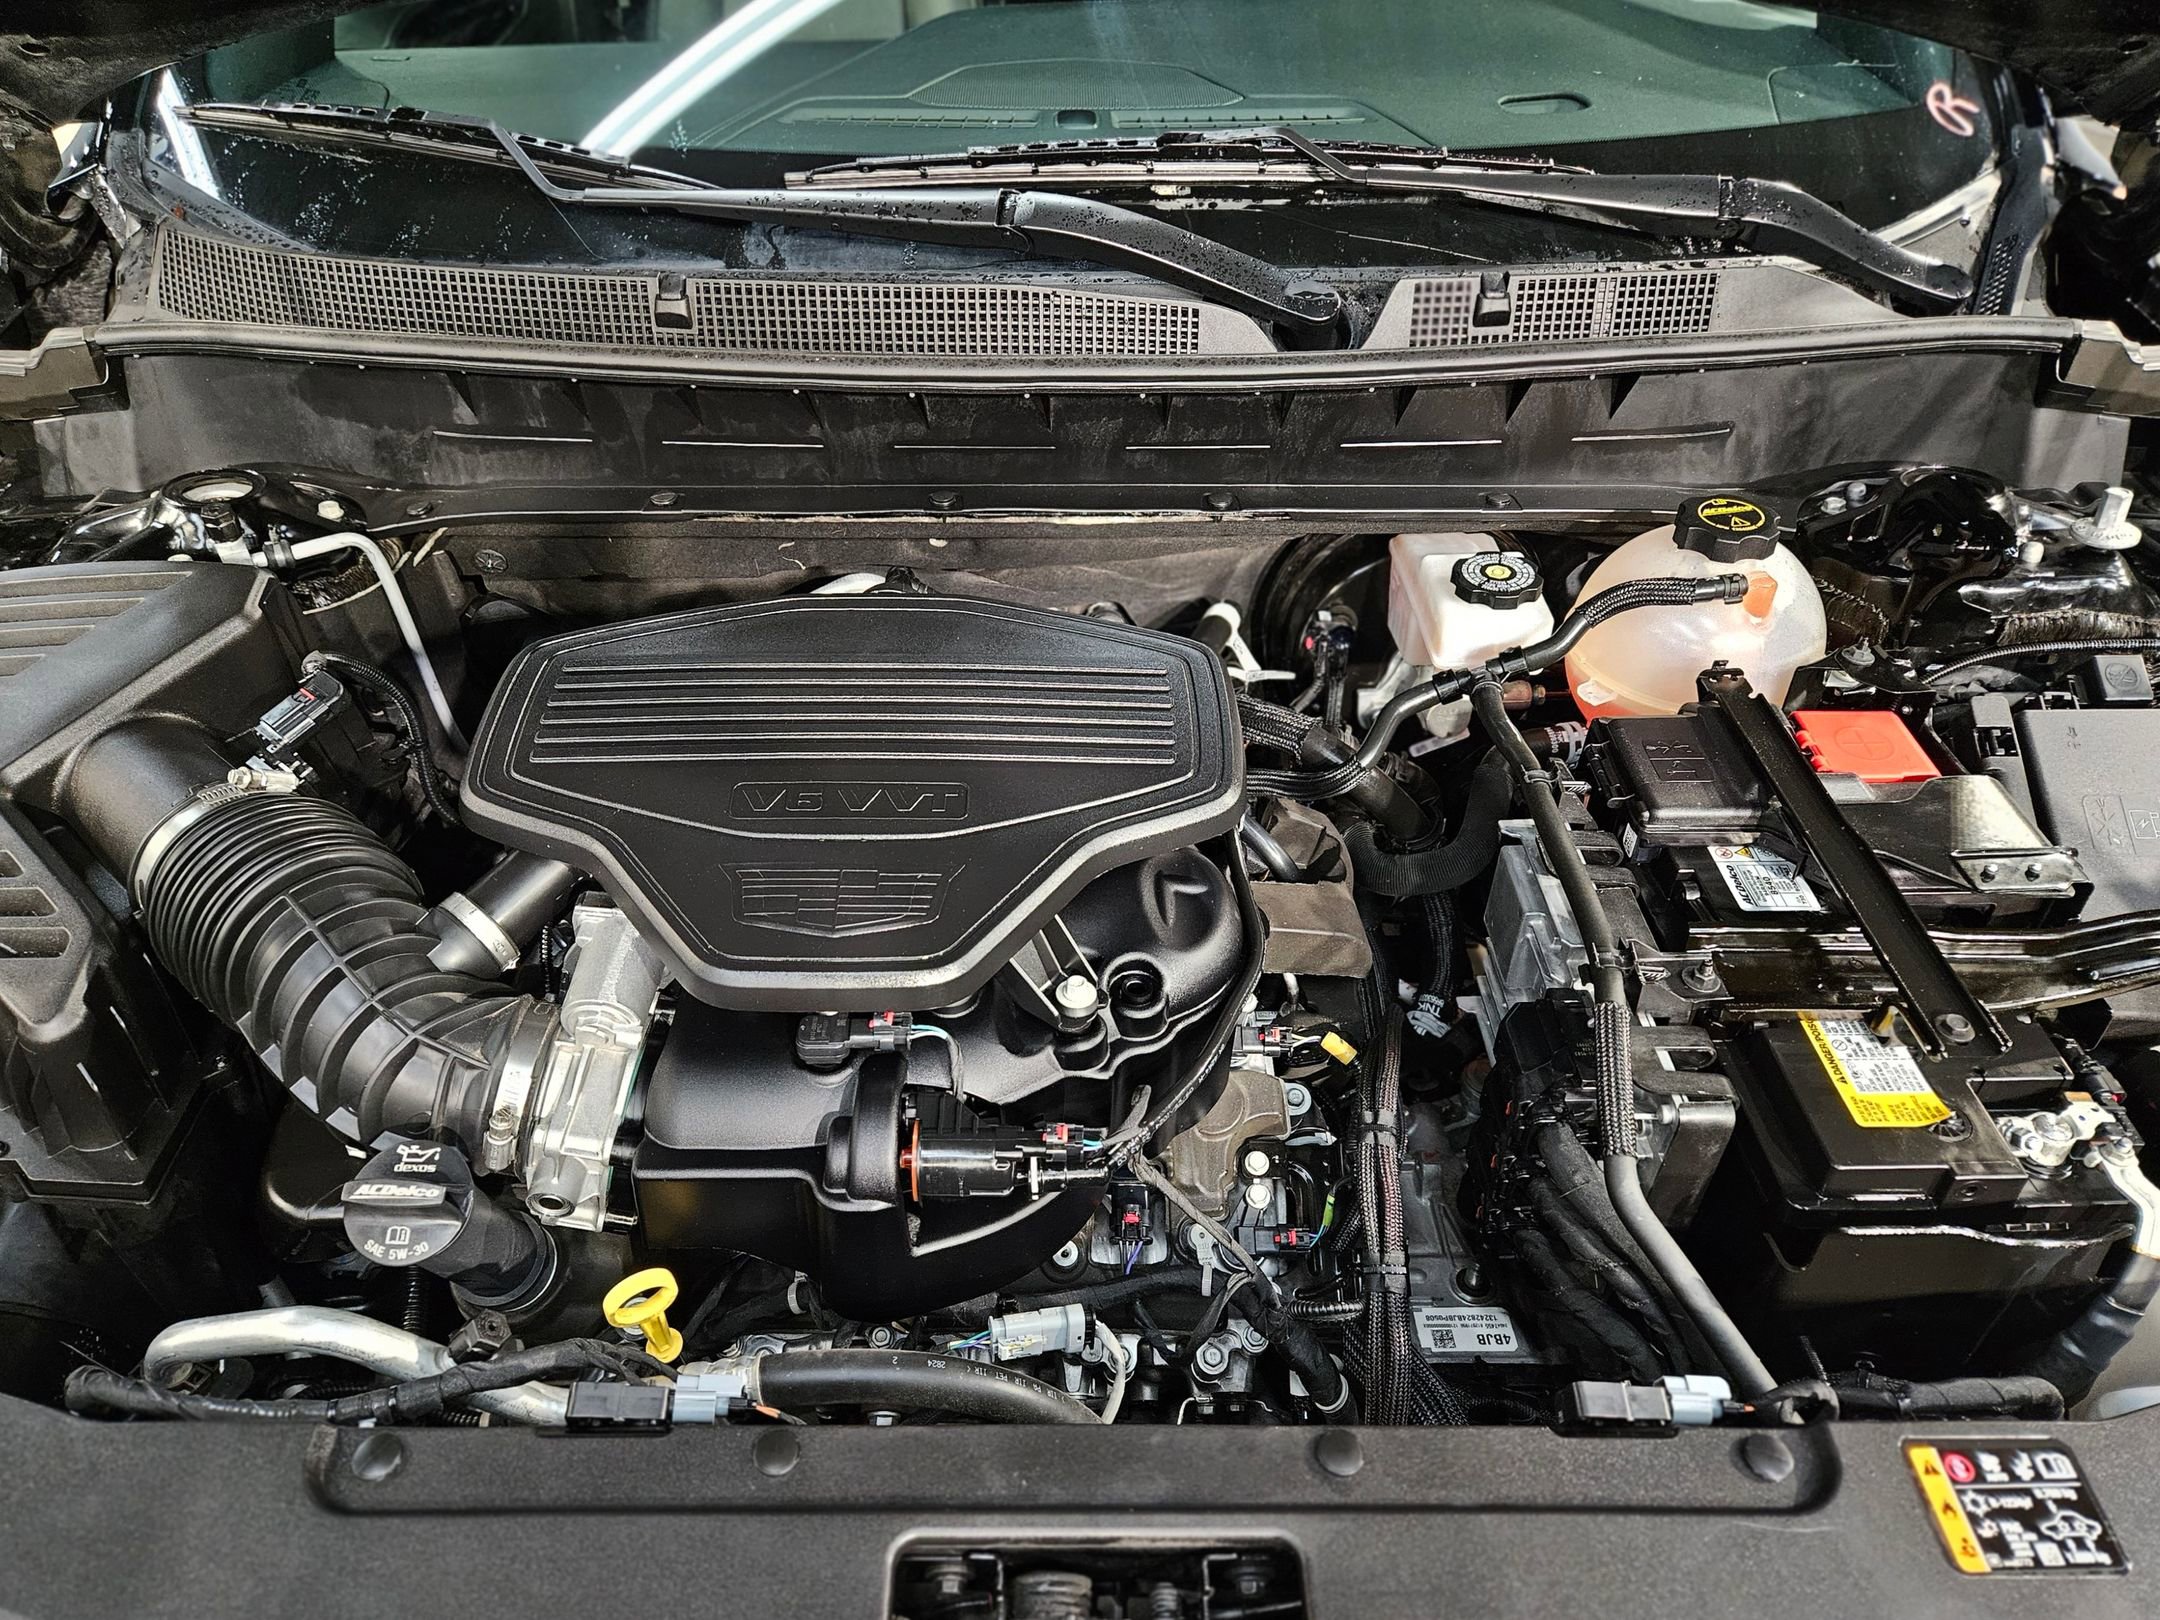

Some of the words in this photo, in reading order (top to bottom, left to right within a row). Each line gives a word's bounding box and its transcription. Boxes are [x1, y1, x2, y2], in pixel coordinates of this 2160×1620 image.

[742, 789, 824, 811] V6
[838, 789, 959, 811] VVT
[1725, 864, 1754, 905] ACDelco
[1417, 1002, 1440, 1018] TNK
[1806, 1020, 1842, 1075] DANGER/POIS
[394, 1162, 437, 1173] dexos
[354, 1184, 439, 1196] ACDelco
[364, 1239, 386, 1258] SAE
[388, 1241, 429, 1260] 5W-30
[1476, 1333, 1511, 1345] 4BJB
[927, 1358, 946, 1369] 2824
[995, 1371, 1009, 1382] PET
